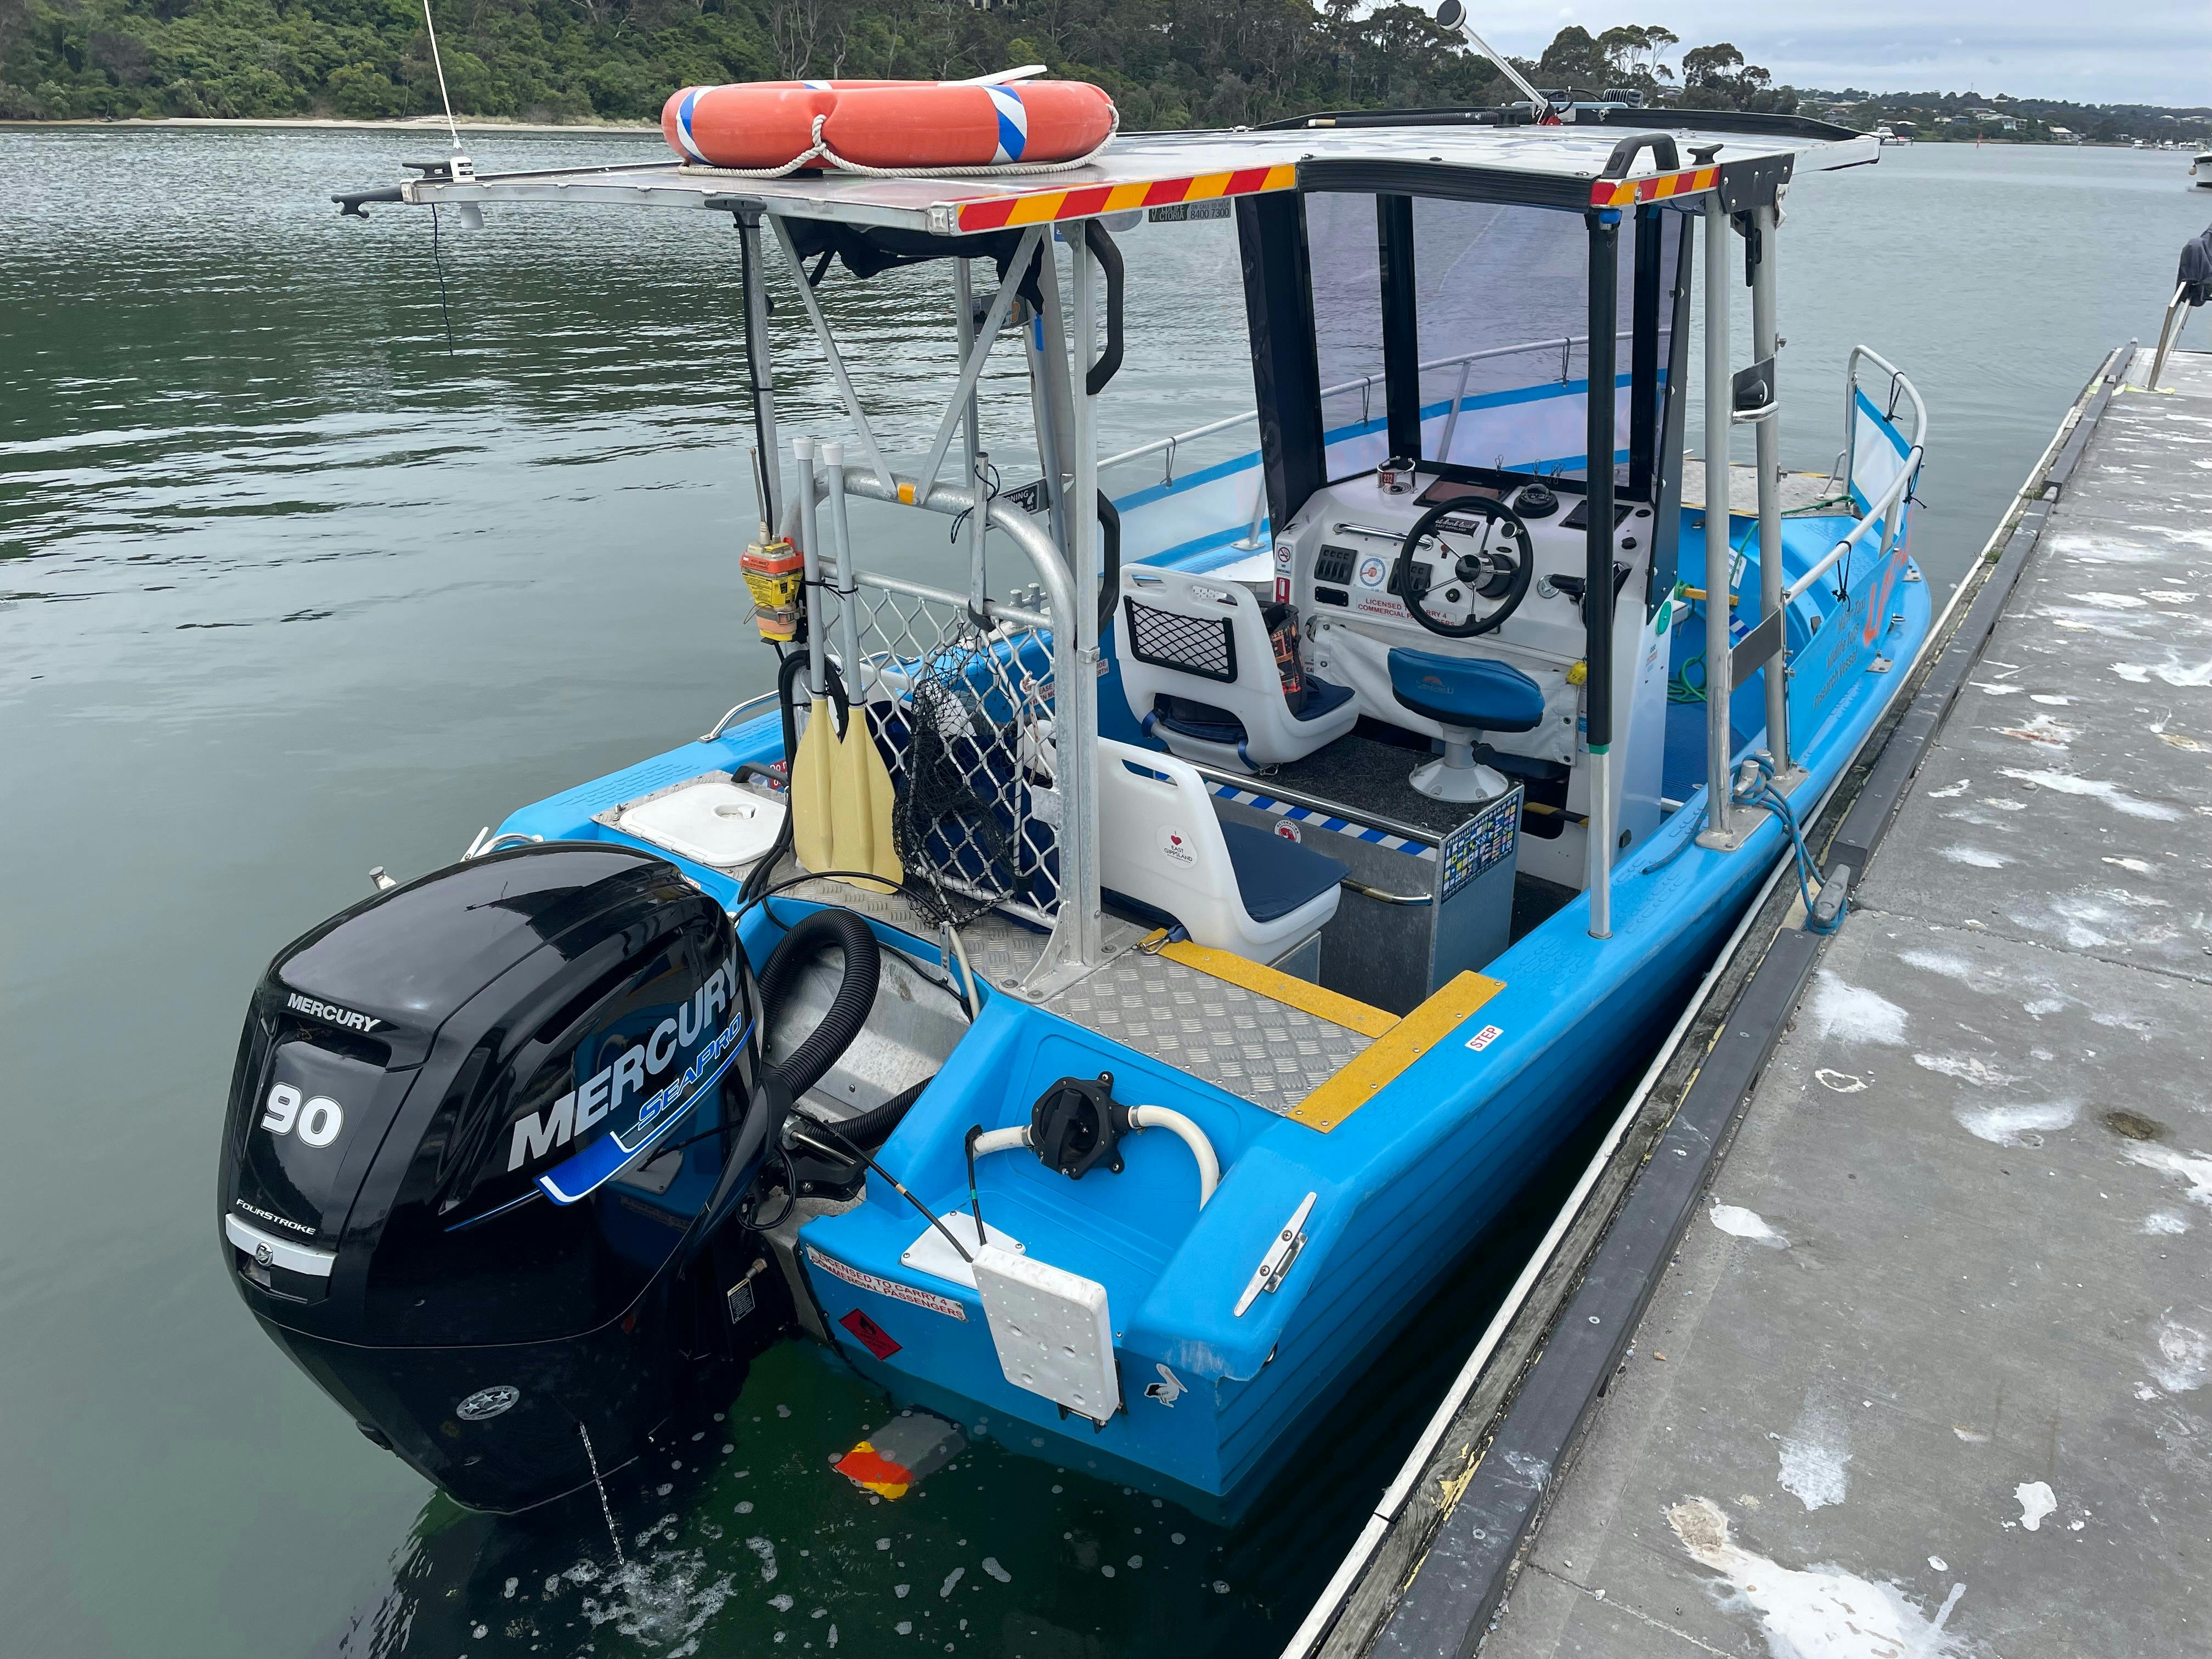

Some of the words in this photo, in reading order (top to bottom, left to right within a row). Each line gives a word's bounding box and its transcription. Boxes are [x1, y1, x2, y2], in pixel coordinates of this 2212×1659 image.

[1152, 210, 1184, 221] VCTORIA
[1190, 210, 1209, 219] 8400
[1211, 207, 1229, 218] 7300
[1383, 473, 1393, 483] 232
[1006, 490, 1029, 501] RNING
[1459, 521, 1476, 529] local
[1358, 603, 1404, 618] COMMERCIAL
[1365, 598, 1402, 610] LICENSED
[1164, 848, 1193, 862] GIPPSLAND
[1171, 845, 1184, 854] EAST
[287, 992, 381, 1032] MERCURY
[1470, 1027, 1497, 1048] STEP
[507, 957, 740, 1172] MERCURY
[637, 1011, 741, 1131] SEAPRO
[260, 1081, 344, 1148] 90
[236, 1198, 317, 1235] FOURSTROKE
[818, 1252, 872, 1283] LICENSED
[876, 1278, 891, 1289] TO
[895, 1284, 936, 1302] CARRY
[810, 1256, 883, 1293] COMMERCIAL
[883, 1288, 964, 1318] PASSENGERS
